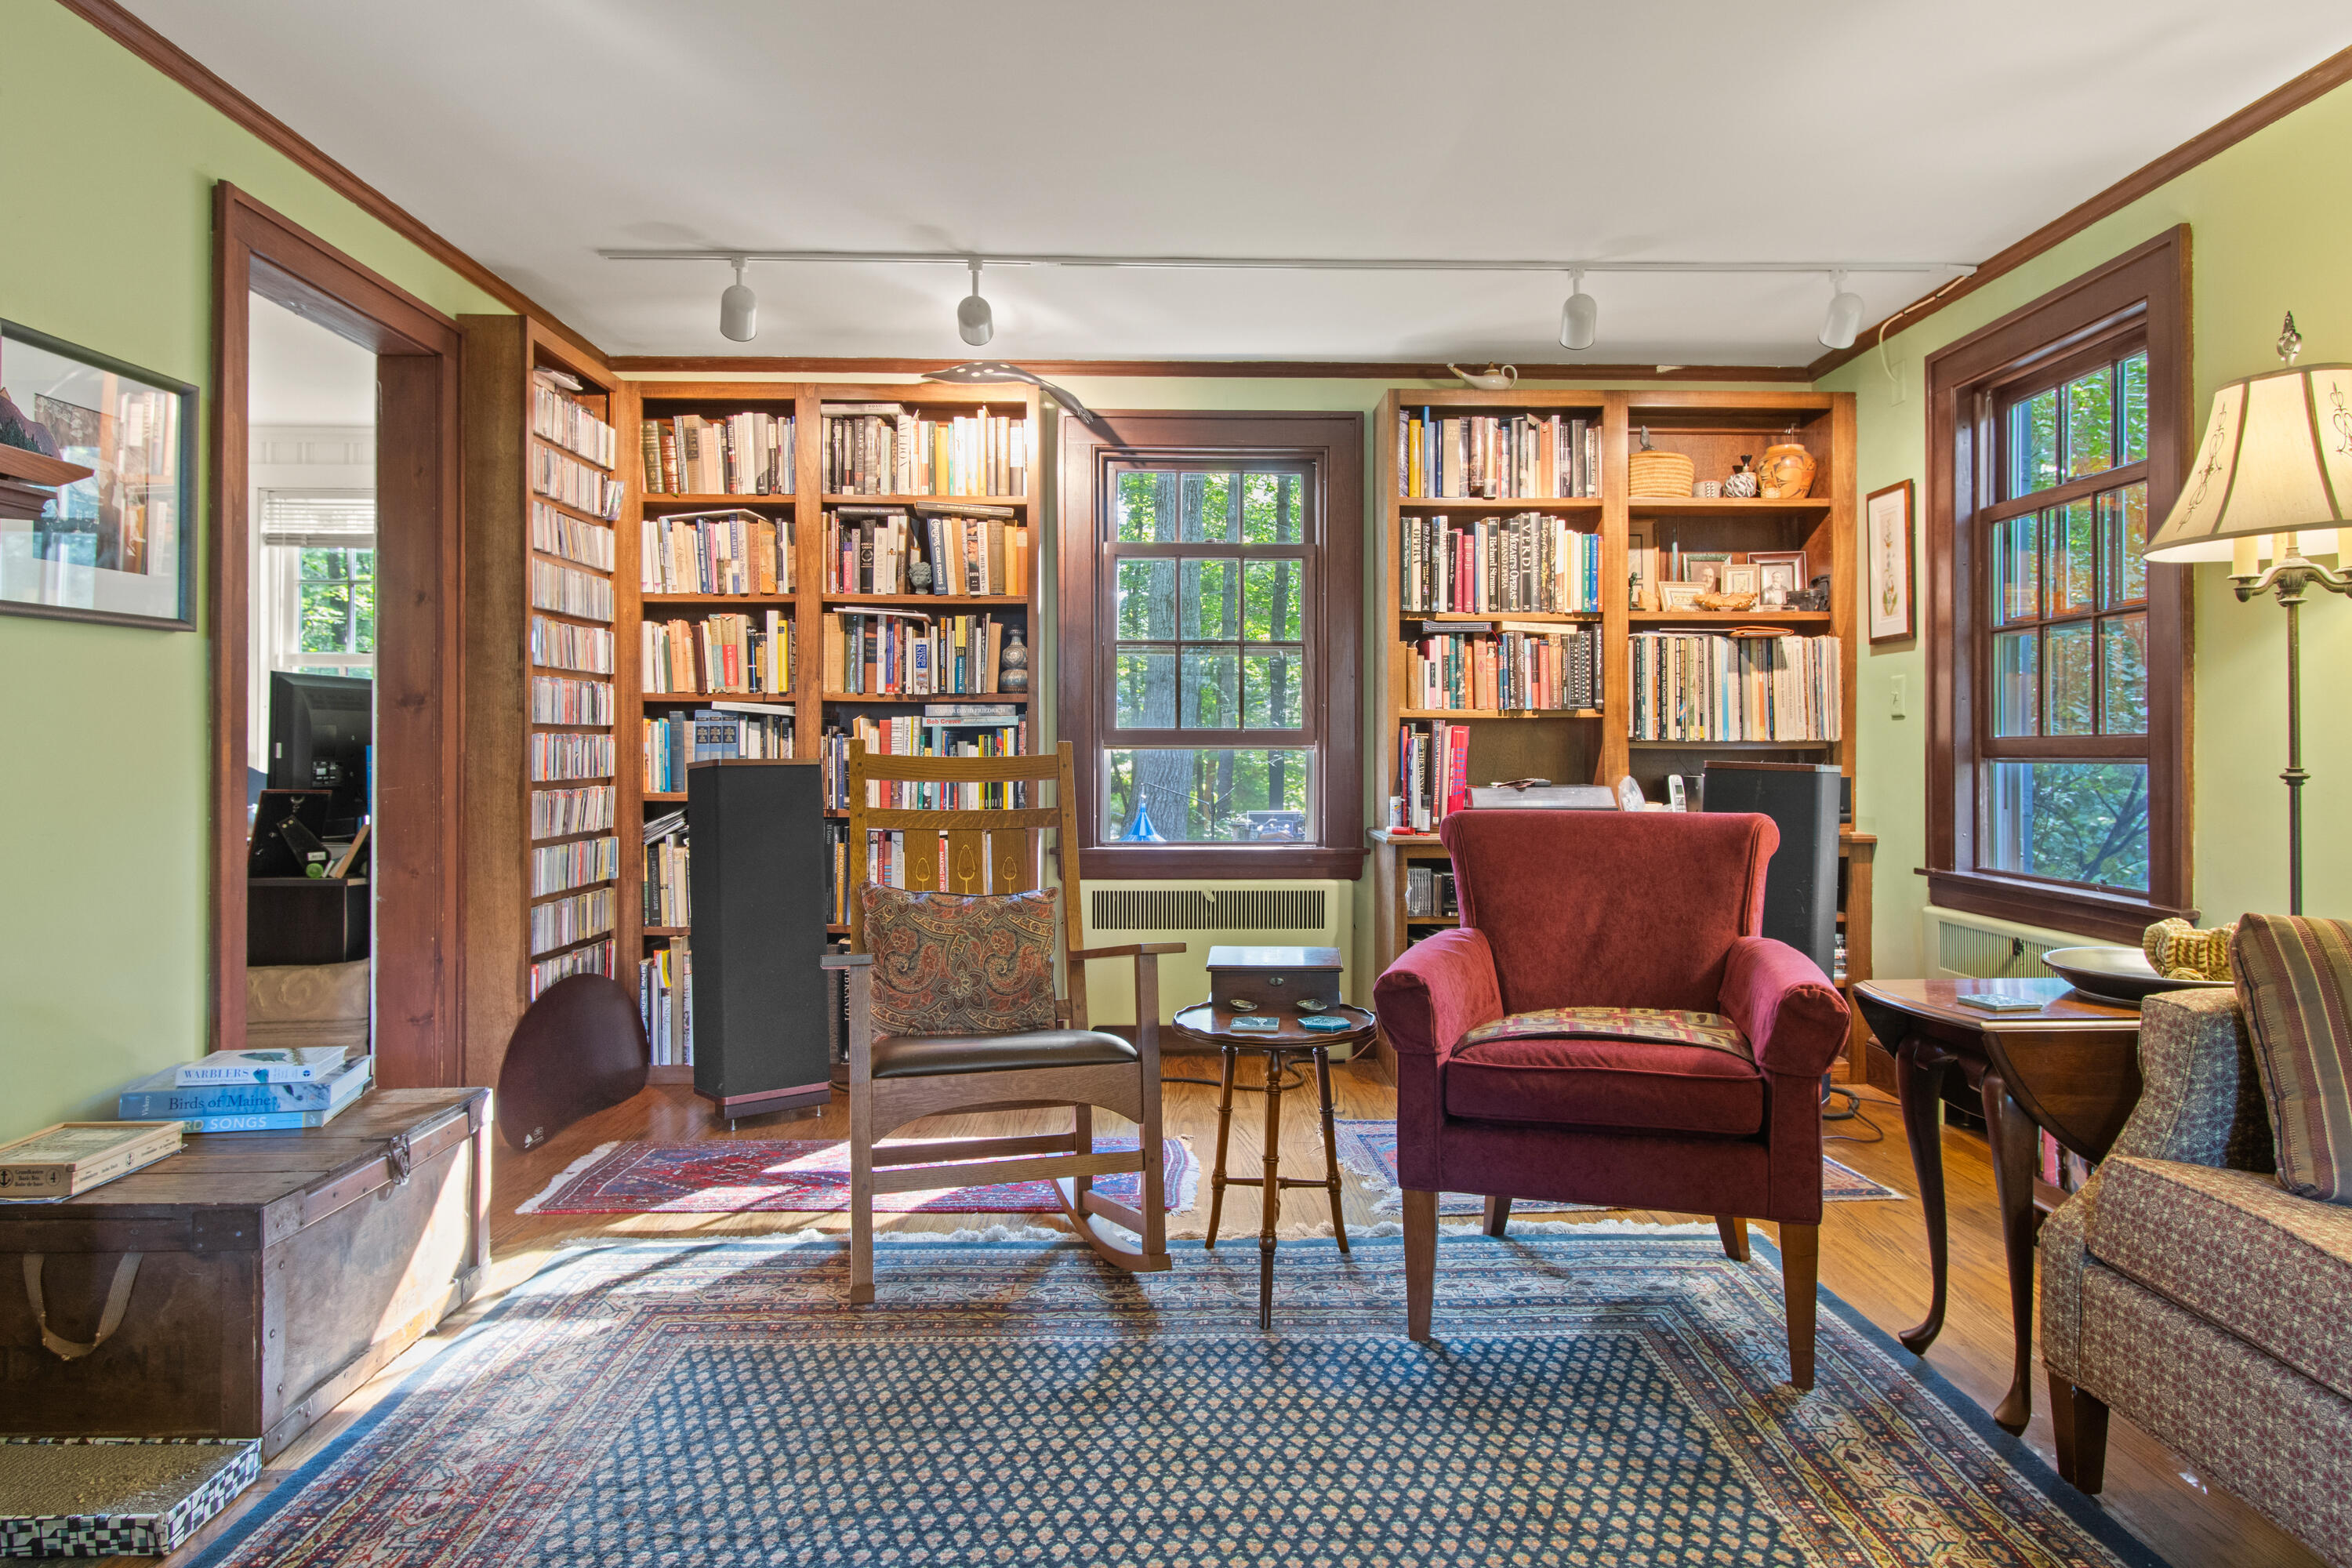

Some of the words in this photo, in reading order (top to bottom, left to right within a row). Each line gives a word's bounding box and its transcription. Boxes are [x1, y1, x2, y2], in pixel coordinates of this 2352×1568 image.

[898, 422, 908, 470] AVEDON
[931, 519, 942, 546] CHRISTMAS
[1413, 528, 1421, 564] OPERA
[1489, 535, 1498, 566] Richard
[1509, 532, 1519, 569] MOZART'S
[1522, 523, 1531, 574] VERDI
[1489, 567, 1498, 596] Strauss
[1509, 570, 1519, 600] OPERAS
[1453, 747, 1466, 796] OPERA
[829, 978, 838, 988] OF
[829, 989, 838, 1004] THE
[829, 1004, 838, 1054] RENAISSANCE
[183, 1068, 250, 1080] WARBLERS
[141, 1094, 151, 1116] Vickery
[169, 1095, 205, 1111] Birds
[207, 1094, 224, 1109] of
[227, 1093, 271, 1108] Maine
[183, 1116, 204, 1131] RD
[209, 1116, 268, 1131] SONGS
[50, 1171, 56, 1183] 4
